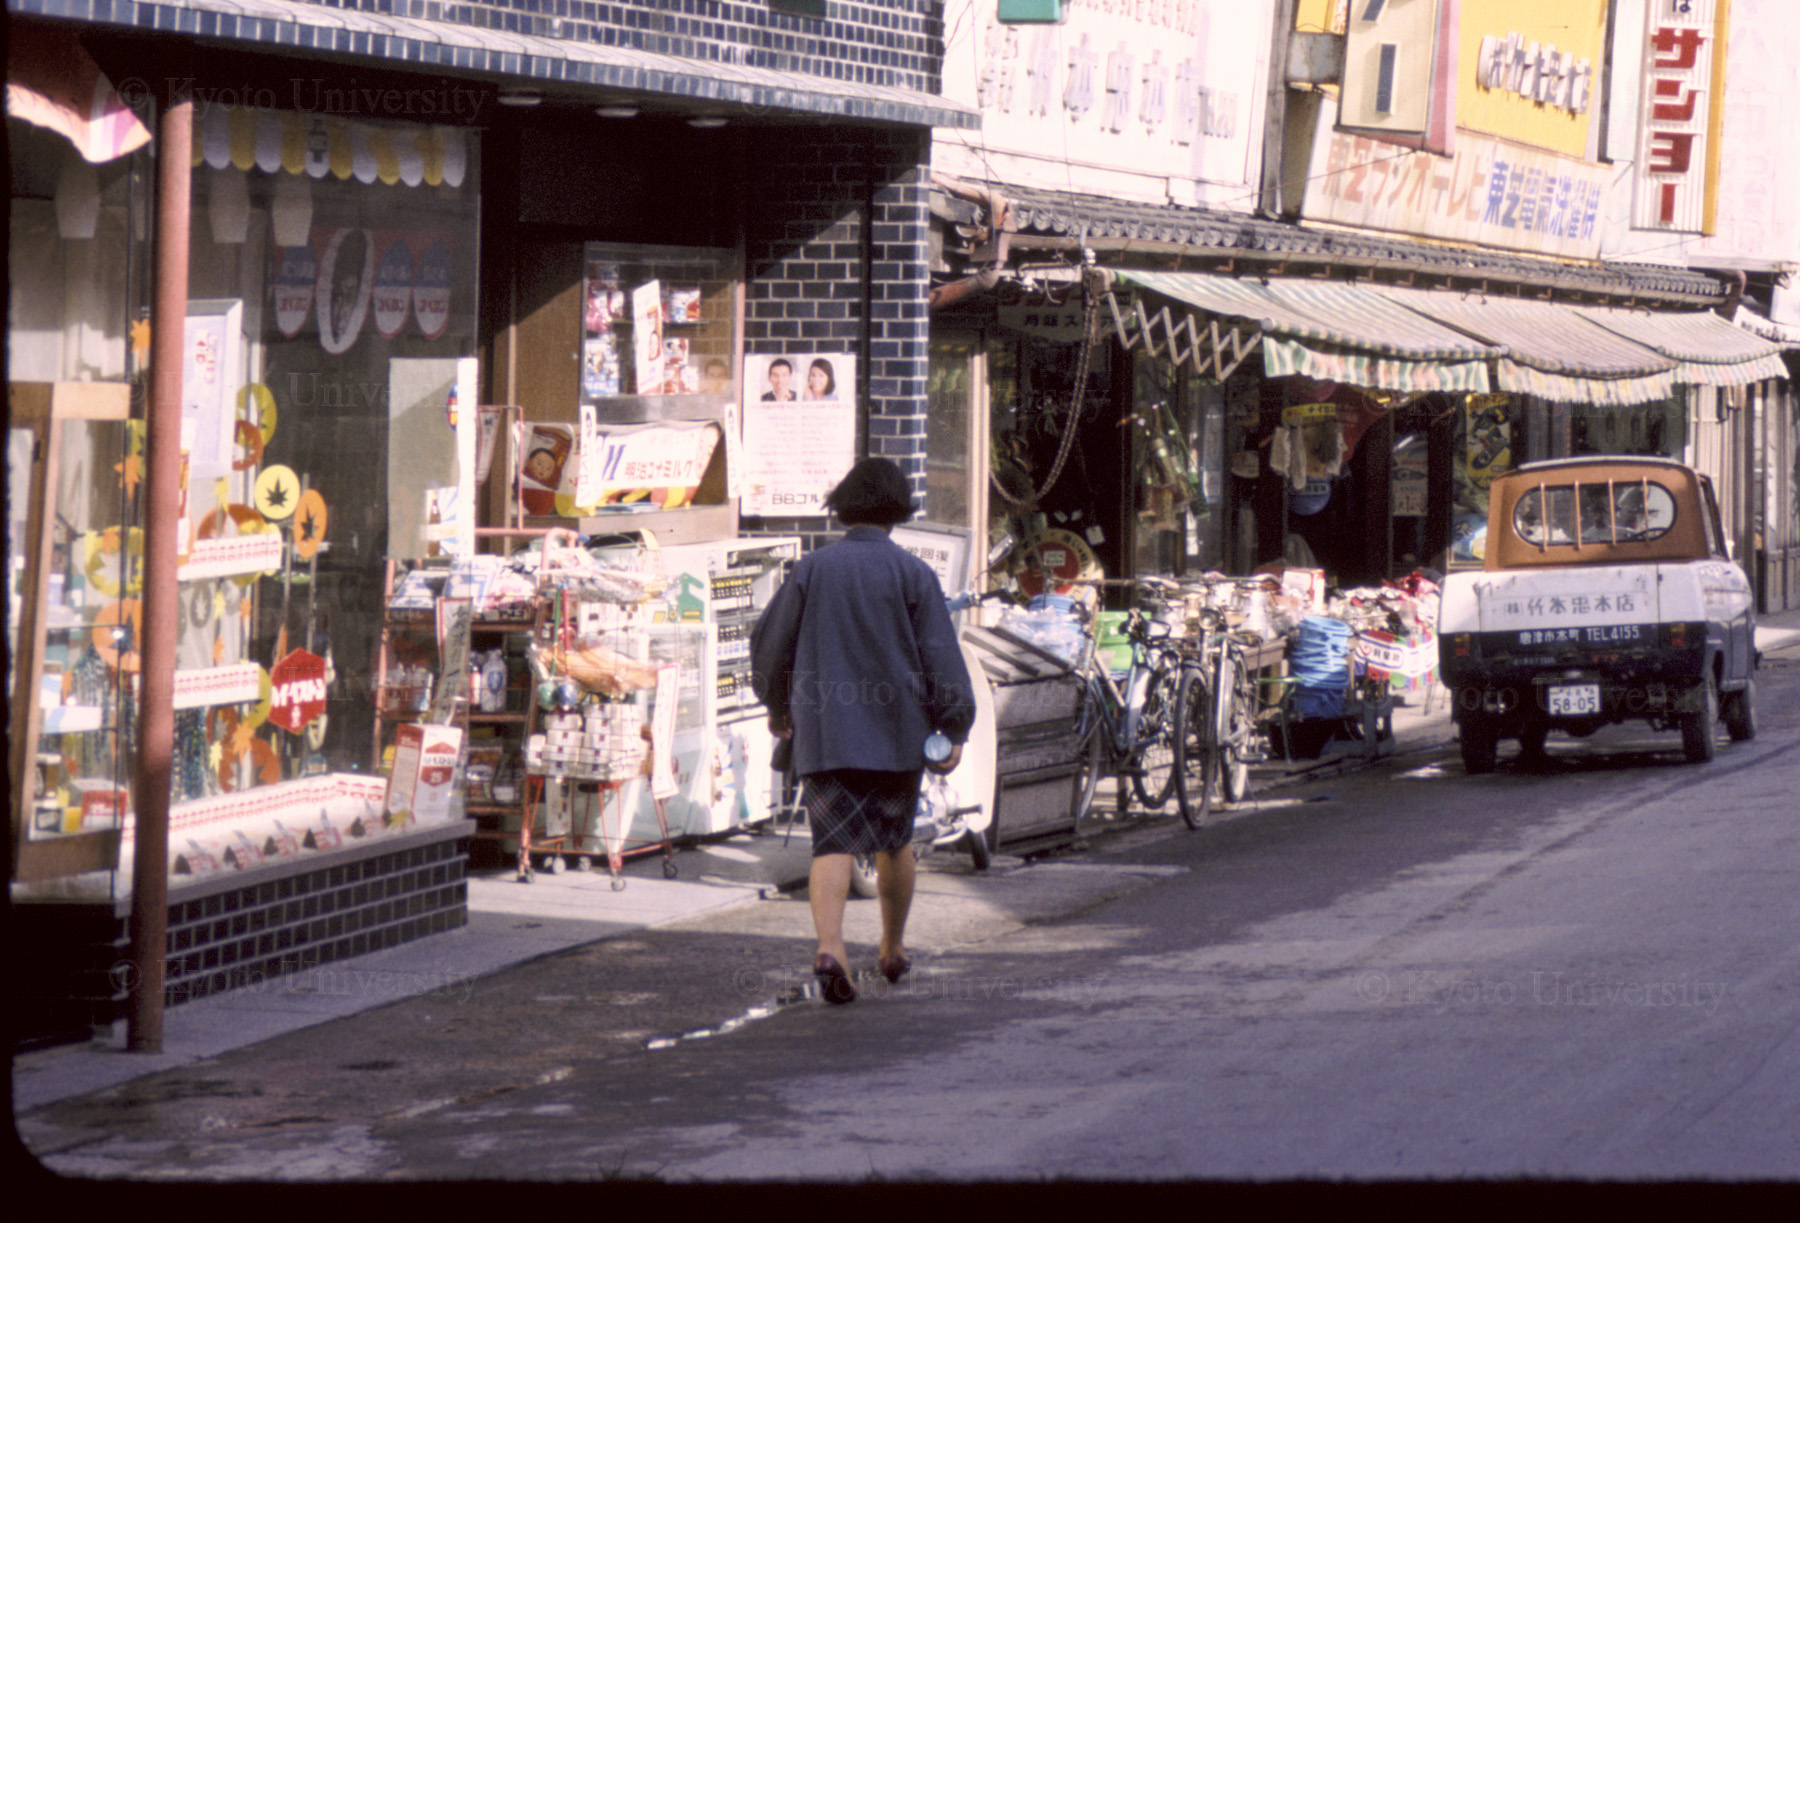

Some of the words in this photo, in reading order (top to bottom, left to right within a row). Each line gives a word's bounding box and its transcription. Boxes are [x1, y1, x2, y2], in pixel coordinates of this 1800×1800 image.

[625, 459, 694, 481] 明治コナミルク
[1519, 629, 1580, 645] 唐津市本町
[1552, 696, 1596, 712] 58-05
